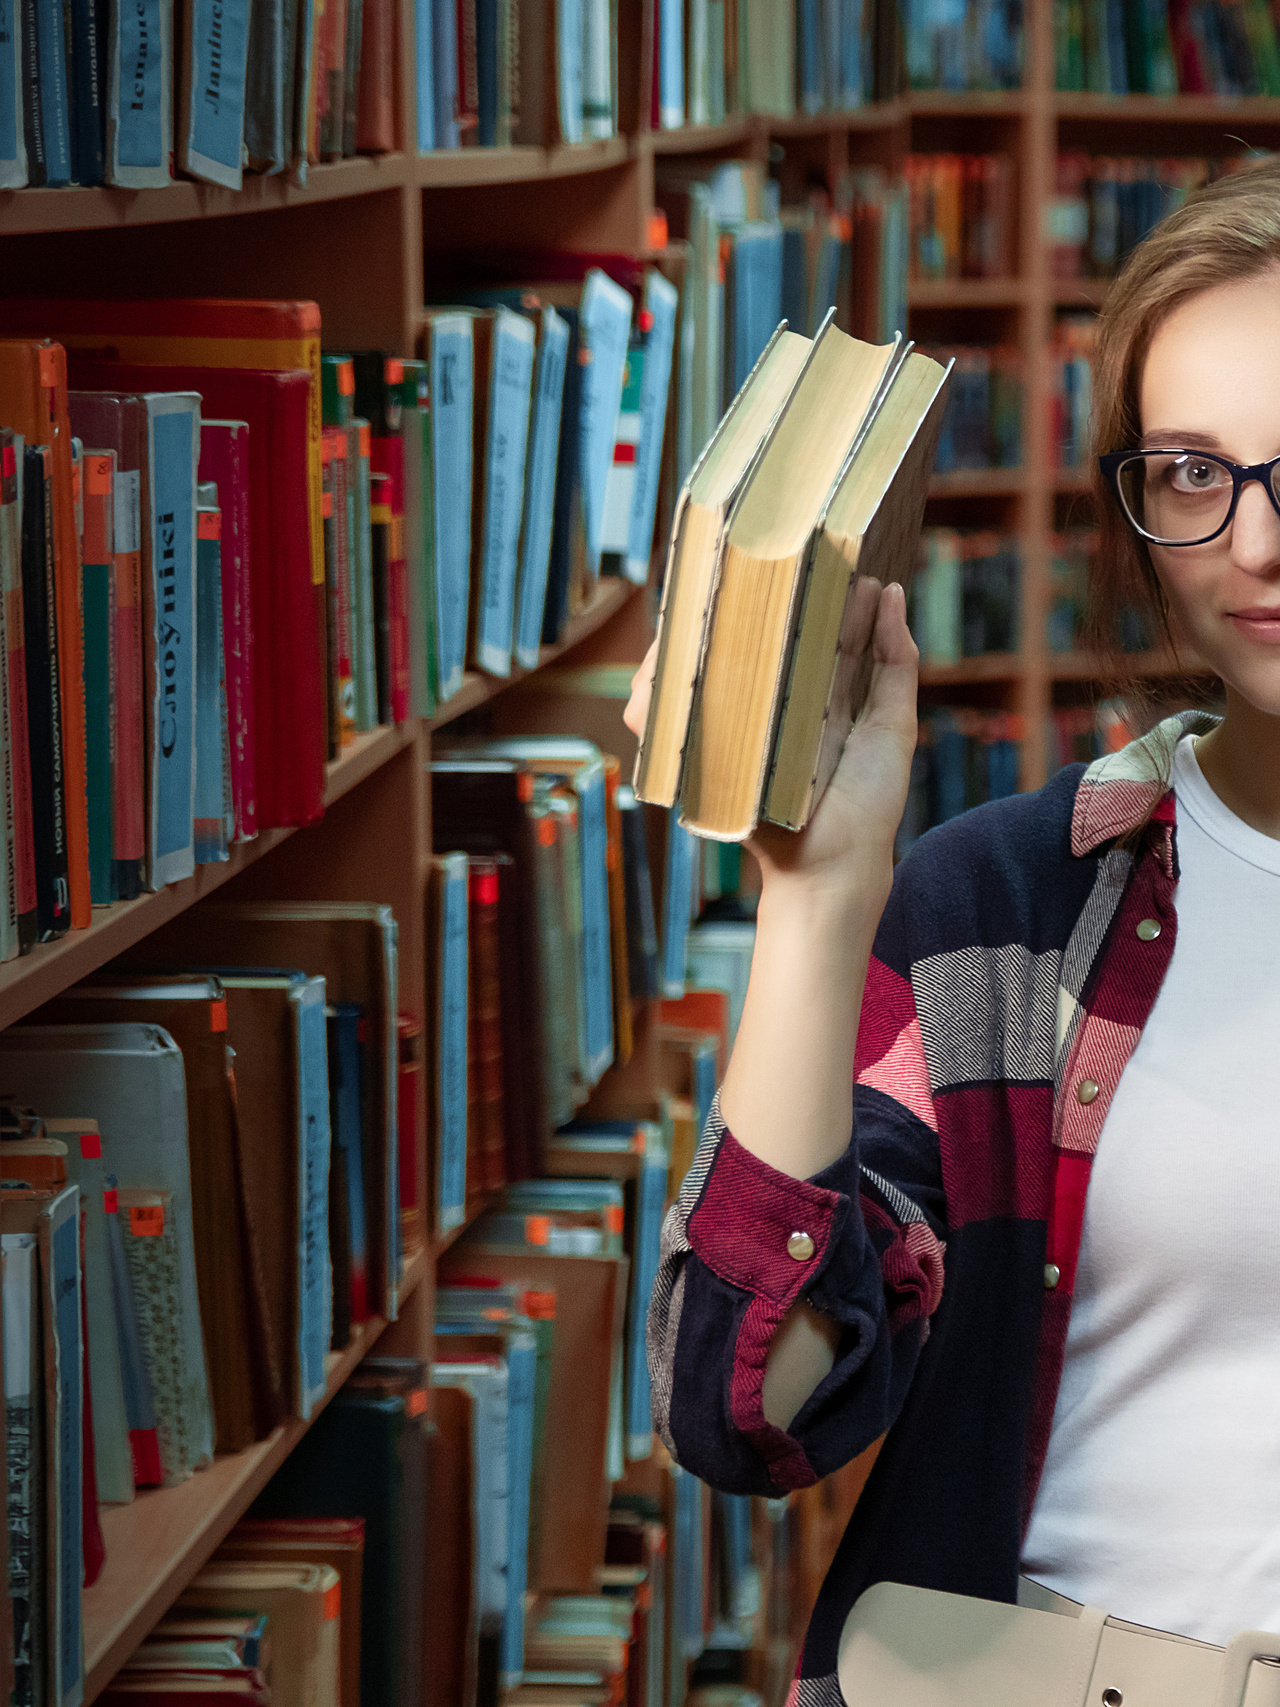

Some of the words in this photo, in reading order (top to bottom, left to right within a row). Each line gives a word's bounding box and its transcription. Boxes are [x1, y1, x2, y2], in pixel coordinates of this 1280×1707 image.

[158, 511, 181, 758] Слоўнікі
[50, 654, 62, 783] САМОУЧИТЕЛЬ
[4, 749, 14, 830] ГЛАГОЛЫ
[52, 787, 63, 854] НОВЫЙ
[6, 838, 16, 927] НЕМЕЦКИЕ
